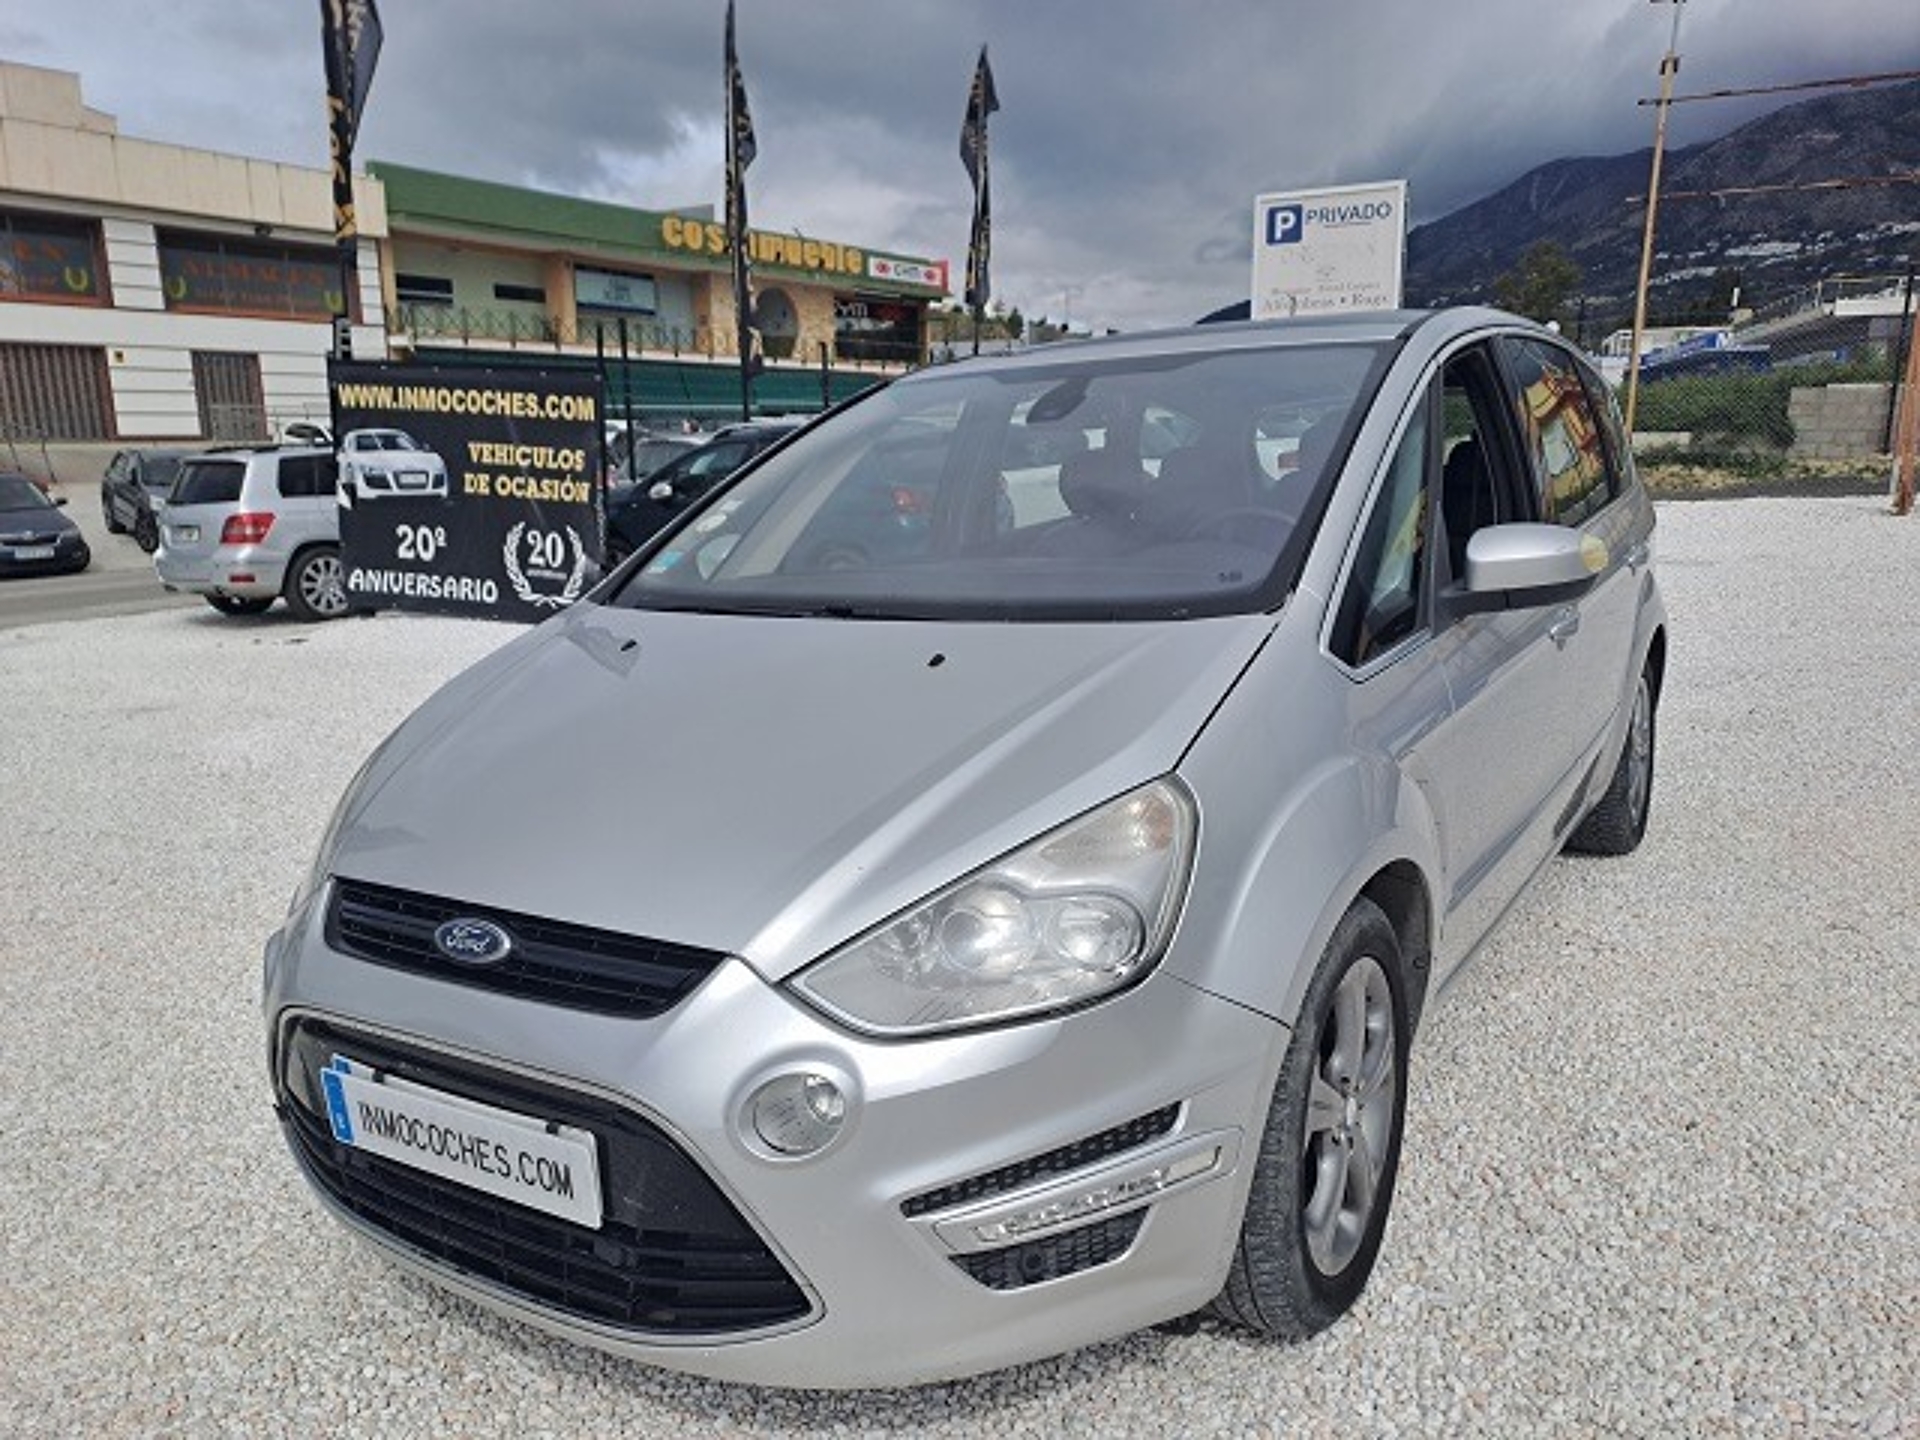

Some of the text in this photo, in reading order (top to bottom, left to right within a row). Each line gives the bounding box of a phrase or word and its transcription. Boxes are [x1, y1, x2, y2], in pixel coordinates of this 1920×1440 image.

[1274, 202, 1392, 240] P PRIVADO
[338, 384, 595, 421] WWW.INMOCOCHES.COM
[467, 442, 586, 472] VEHICULOS
[464, 473, 590, 503] DE OCASIÓN
[528, 530, 564, 568] 20
[348, 567, 499, 604] ANIVERSARIO
[446, 926, 491, 954] Ford
[357, 1101, 574, 1200] INMOCOCHES.COM
